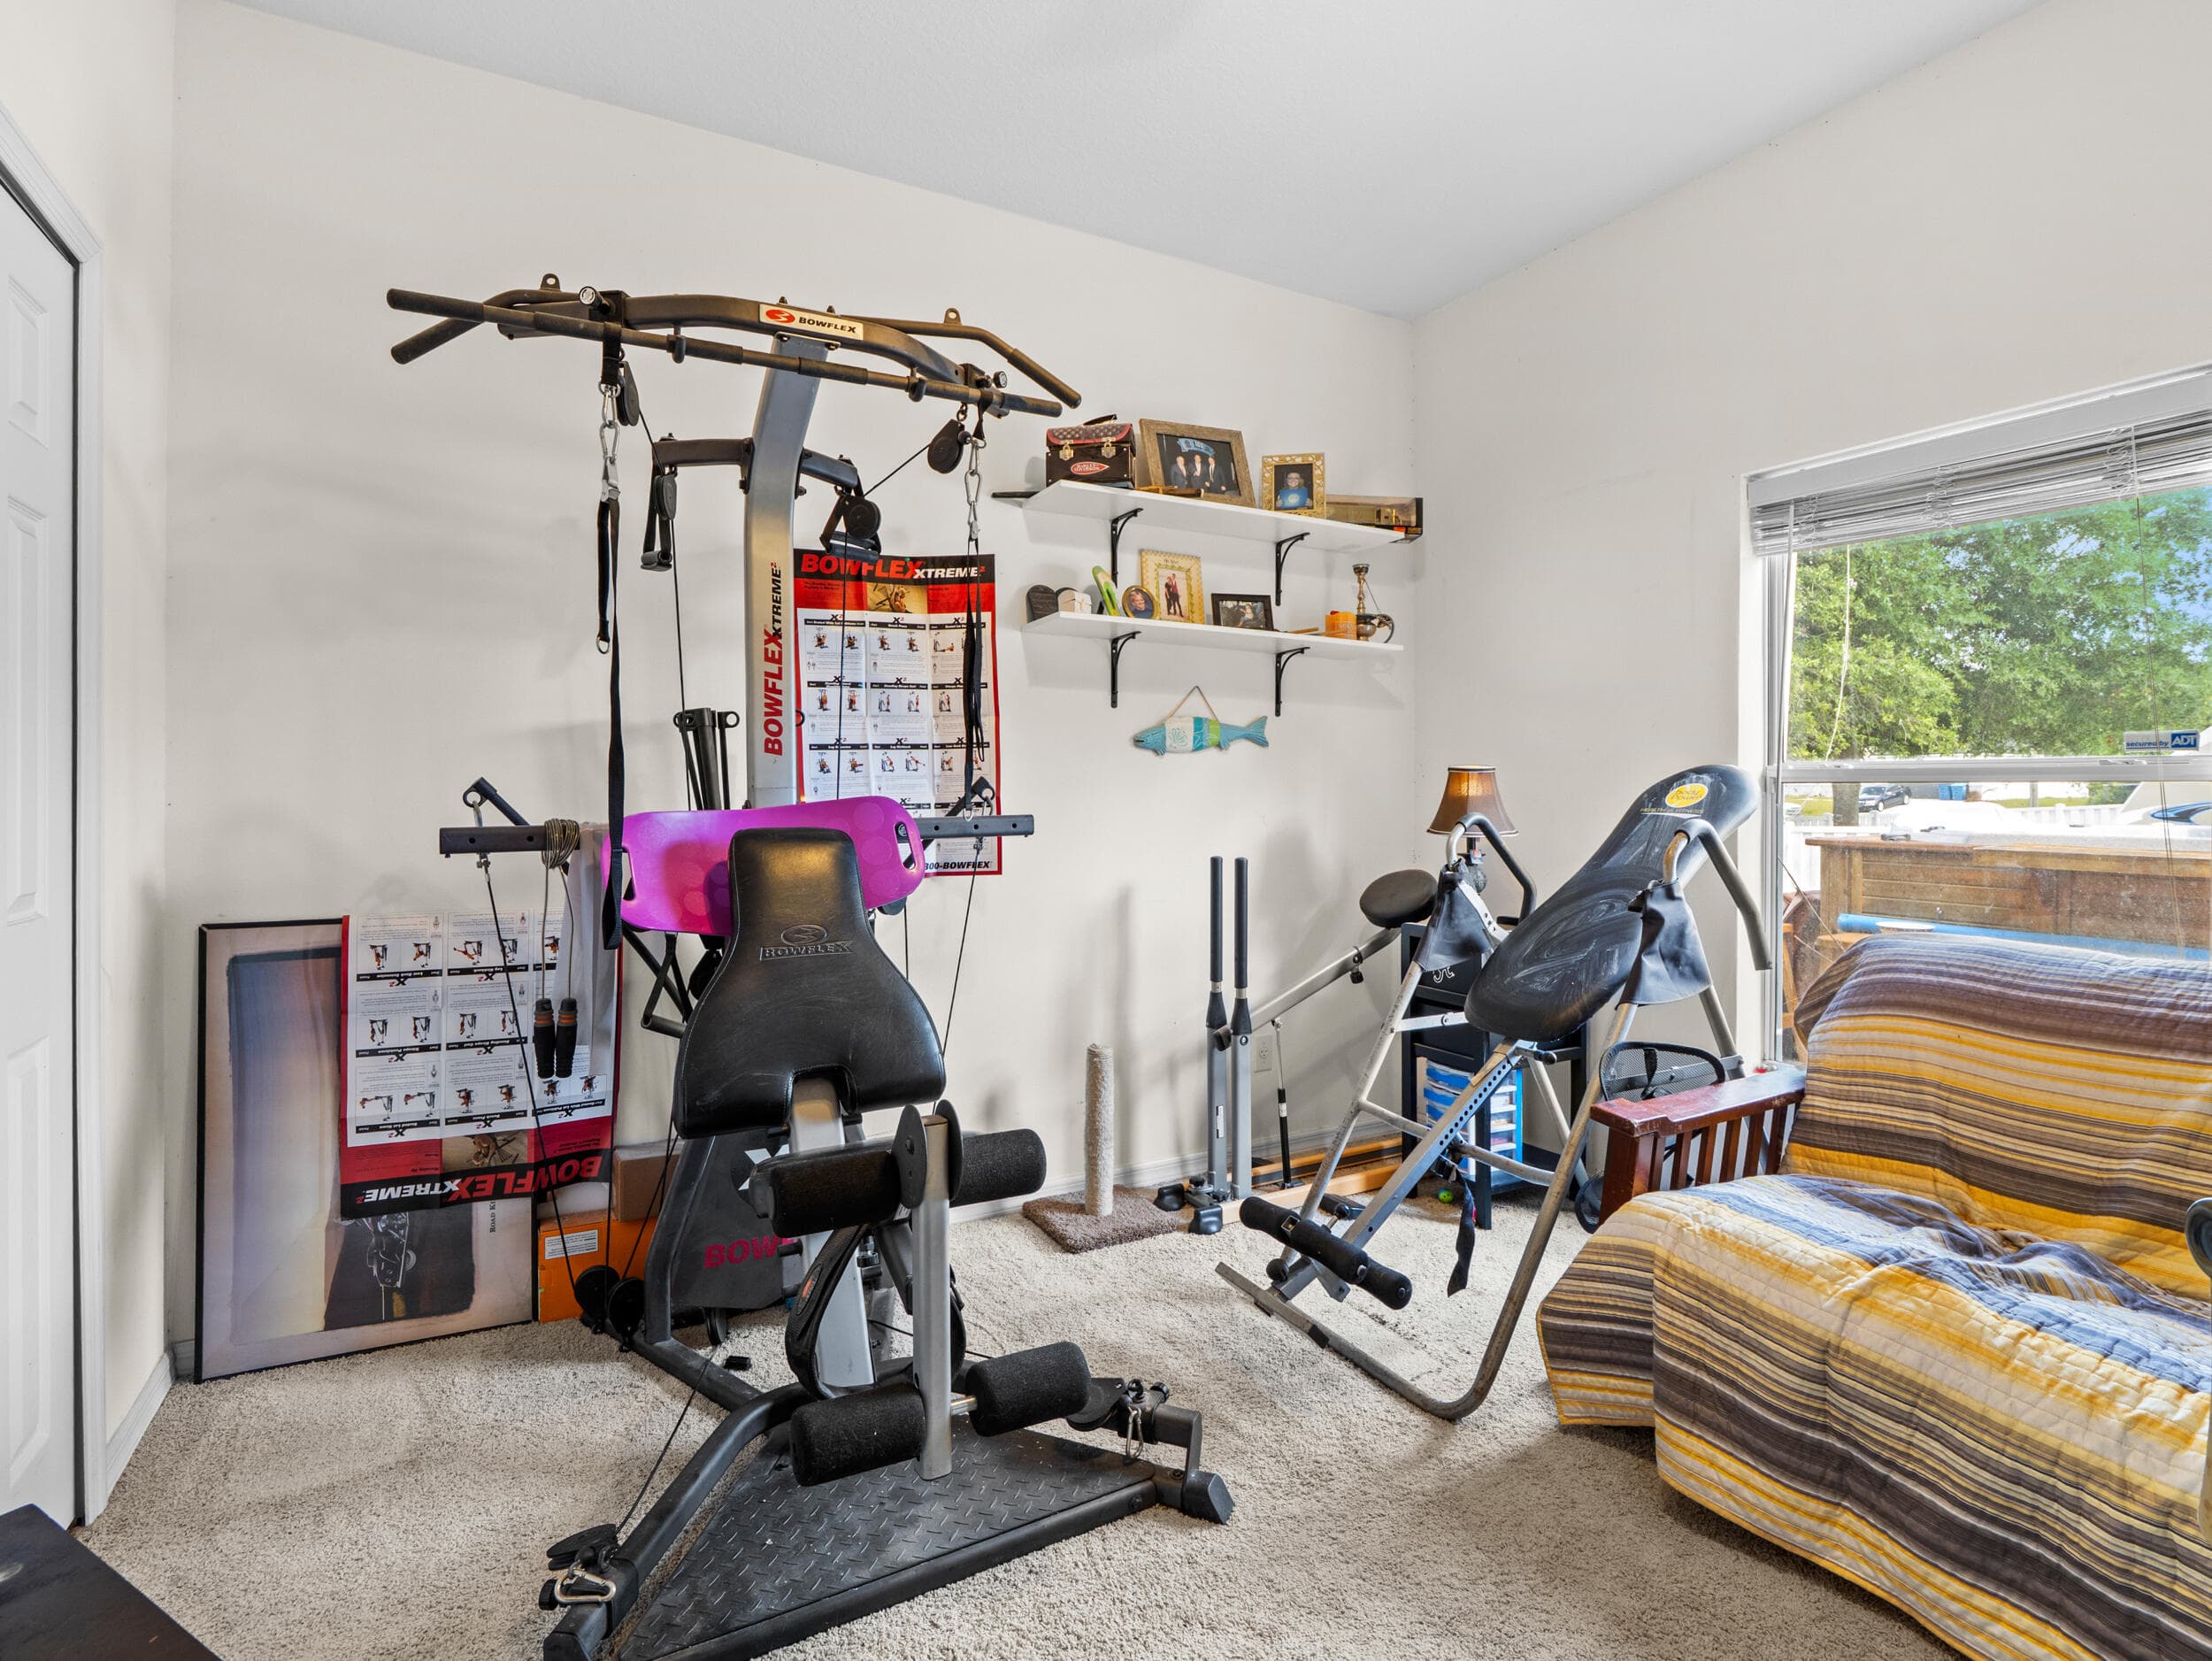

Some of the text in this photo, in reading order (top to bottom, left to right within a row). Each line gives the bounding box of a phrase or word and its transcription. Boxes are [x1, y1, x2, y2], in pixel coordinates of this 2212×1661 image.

[798, 316, 856, 334] BOWFLEX
[801, 553, 923, 580] BOWFLEX
[764, 627, 783, 757] BOWFLEX
[2171, 735, 2195, 746] ADT
[765, 941, 853, 957] BOWFLEX
[444, 1156, 603, 1202] BOWFLEX
